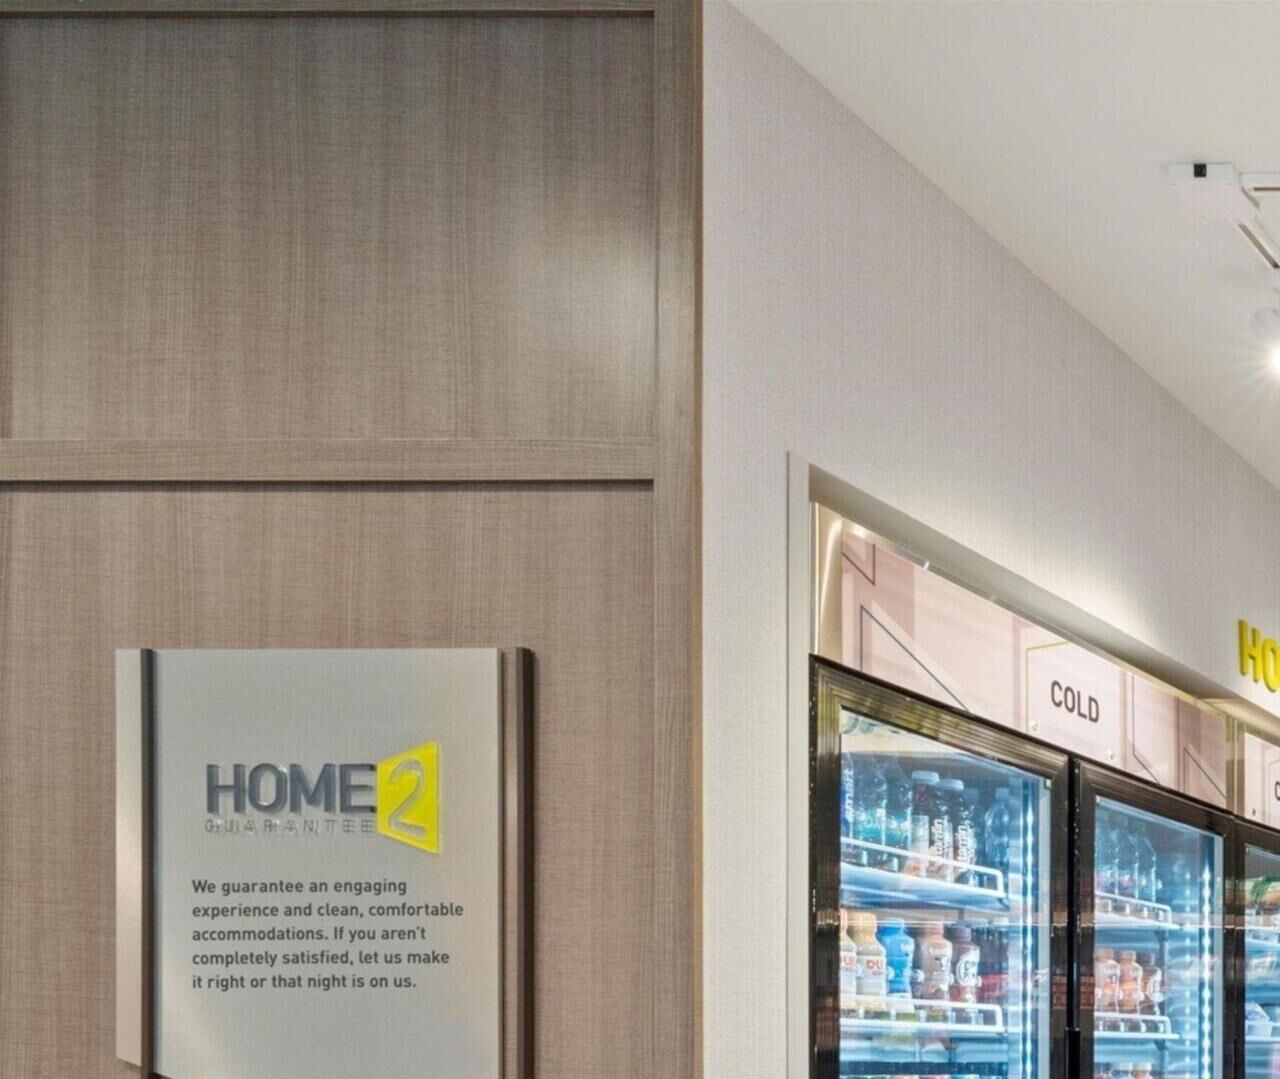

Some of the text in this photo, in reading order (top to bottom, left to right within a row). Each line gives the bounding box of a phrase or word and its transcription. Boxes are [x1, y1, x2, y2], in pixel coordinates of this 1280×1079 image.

[1050, 680, 1100, 724] COLD
[205, 819, 375, 834] GUARANTEE
[192, 879, 408, 896] We guarantee an engaging
[192, 902, 464, 920] experience and clean, comfortable
[192, 926, 426, 943] accommodations. If you aren't
[192, 950, 450, 968] completely satisfied, let us make
[192, 974, 416, 991] it right or that night is on us.
